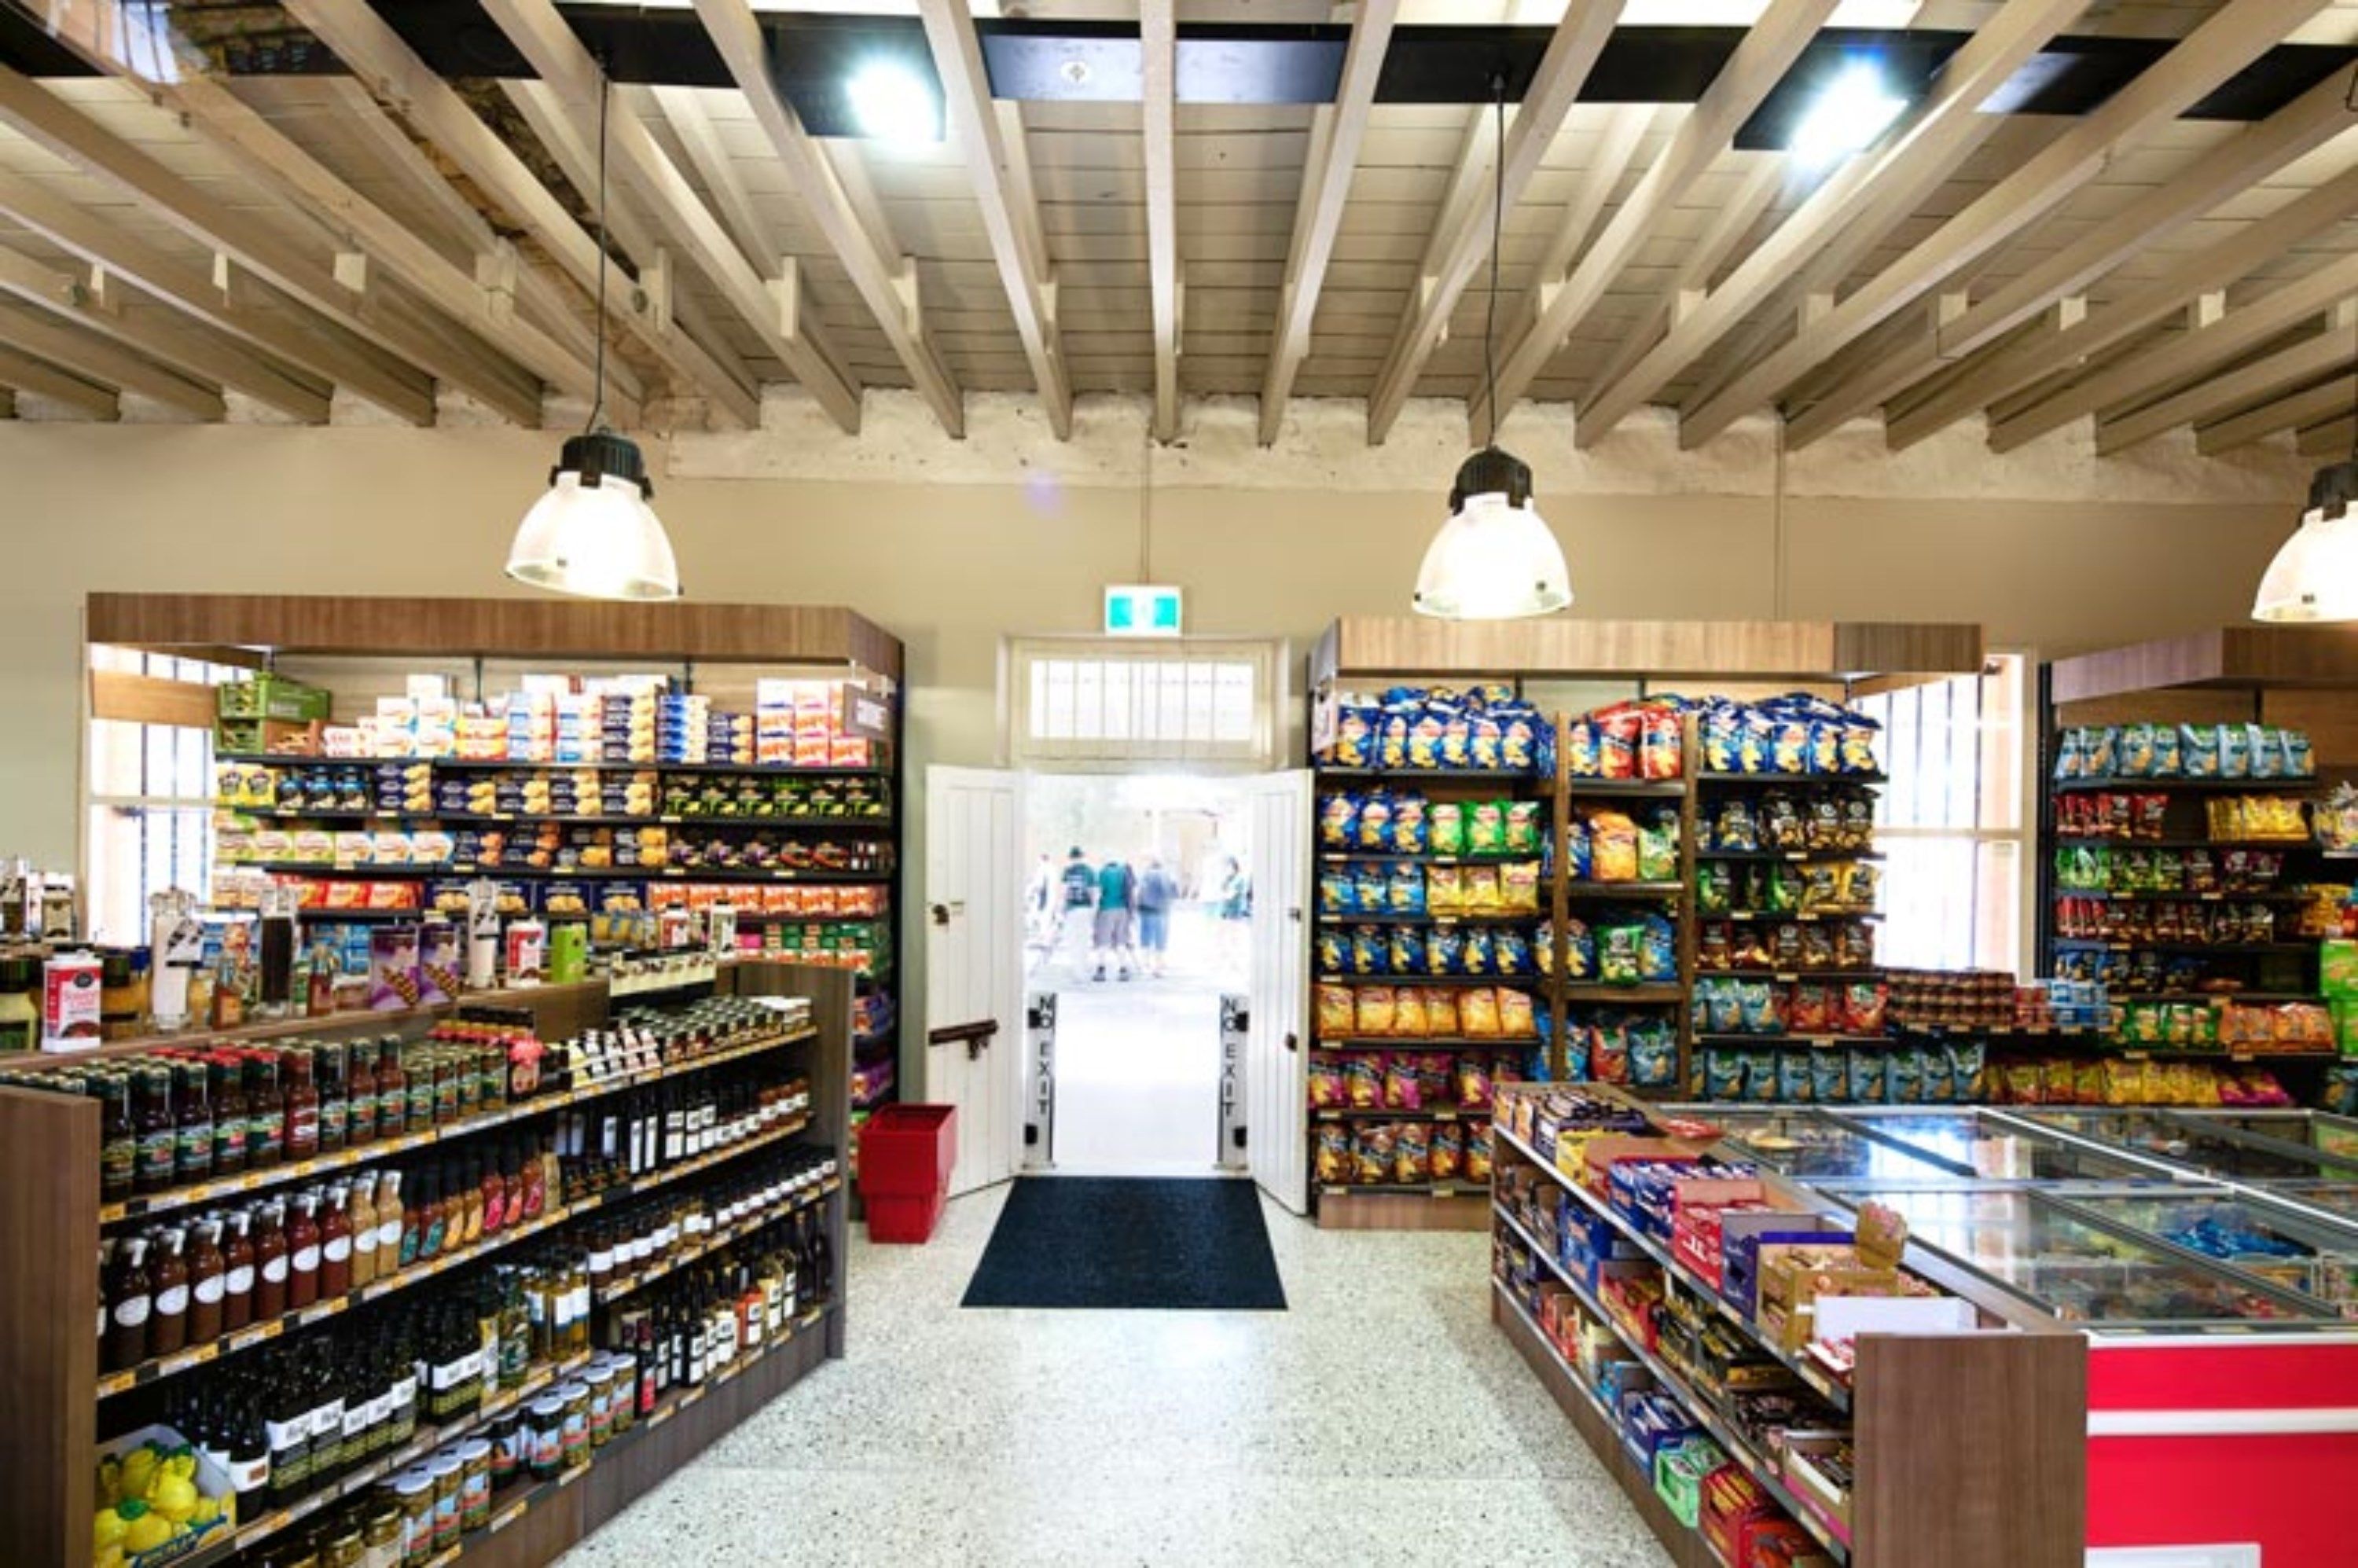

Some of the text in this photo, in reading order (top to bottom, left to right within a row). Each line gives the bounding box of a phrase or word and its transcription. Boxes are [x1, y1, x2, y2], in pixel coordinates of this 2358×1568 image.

[1038, 994, 1054, 1114] NO EXIT
[1223, 998, 1236, 1117] NO EXIT
